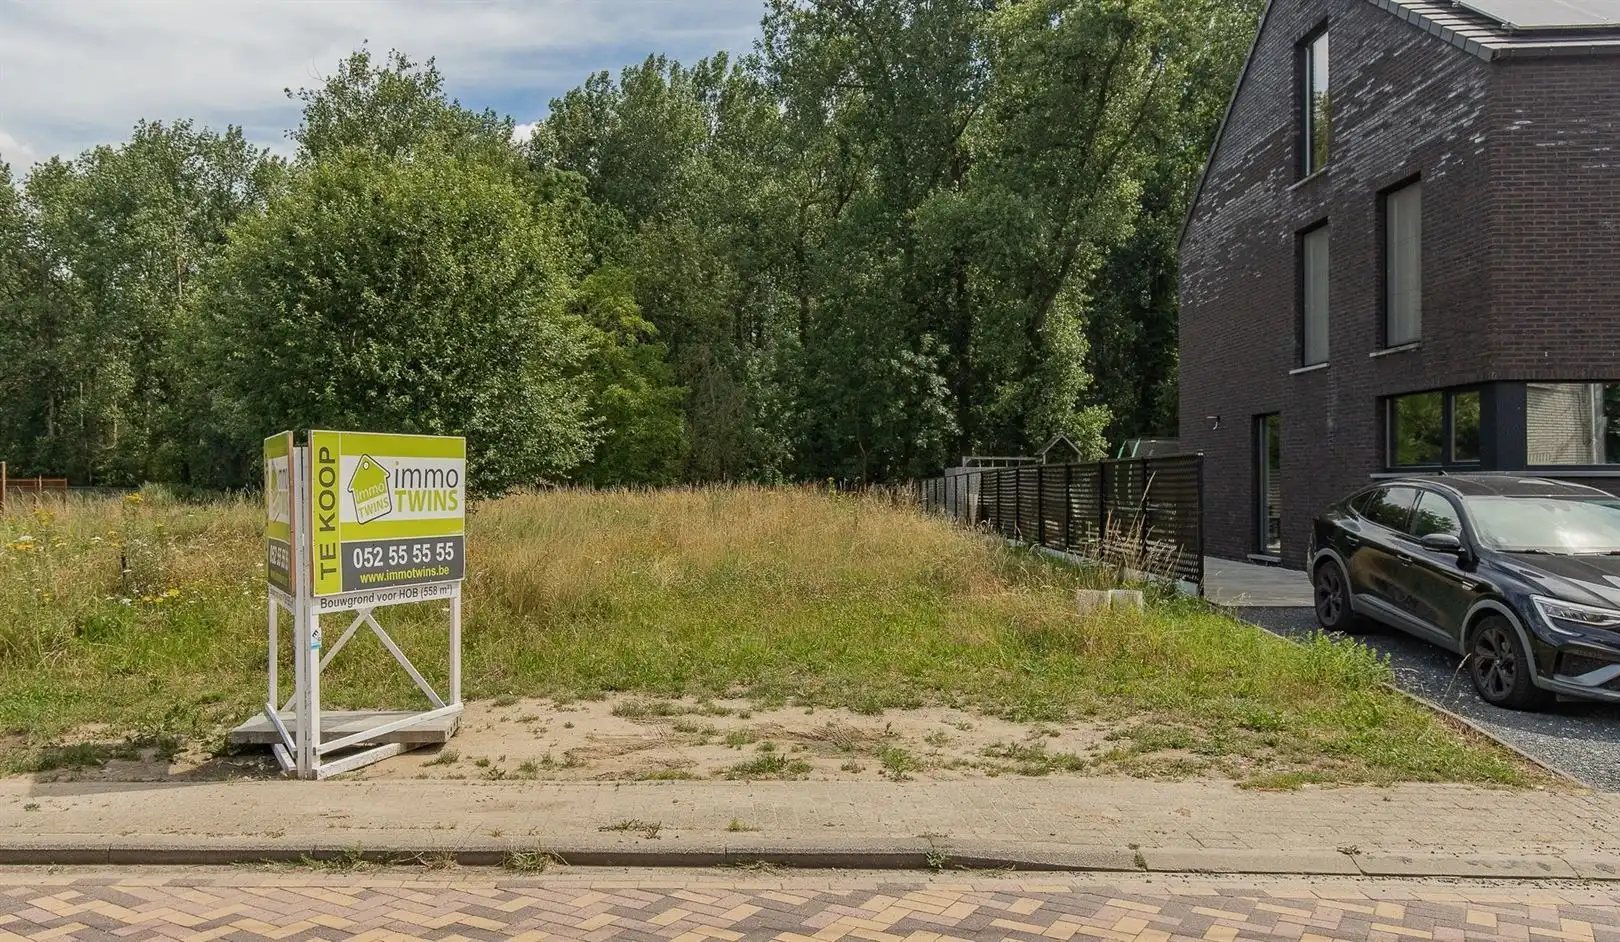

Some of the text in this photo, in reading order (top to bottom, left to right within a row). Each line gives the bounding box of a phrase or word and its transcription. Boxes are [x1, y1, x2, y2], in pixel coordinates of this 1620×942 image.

[394, 461, 459, 489] immo
[318, 446, 337, 580] TE KOOP
[358, 497, 390, 518] TWINS
[394, 489, 458, 513] TWINS
[353, 542, 454, 569] 052 55 55 55
[359, 565, 450, 584] www.immotwins.be
[320, 593, 375, 609] Bouwgrond
[376, 591, 397, 602] voor
[399, 588, 419, 600] HOB
[420, 585, 438, 599] (558
